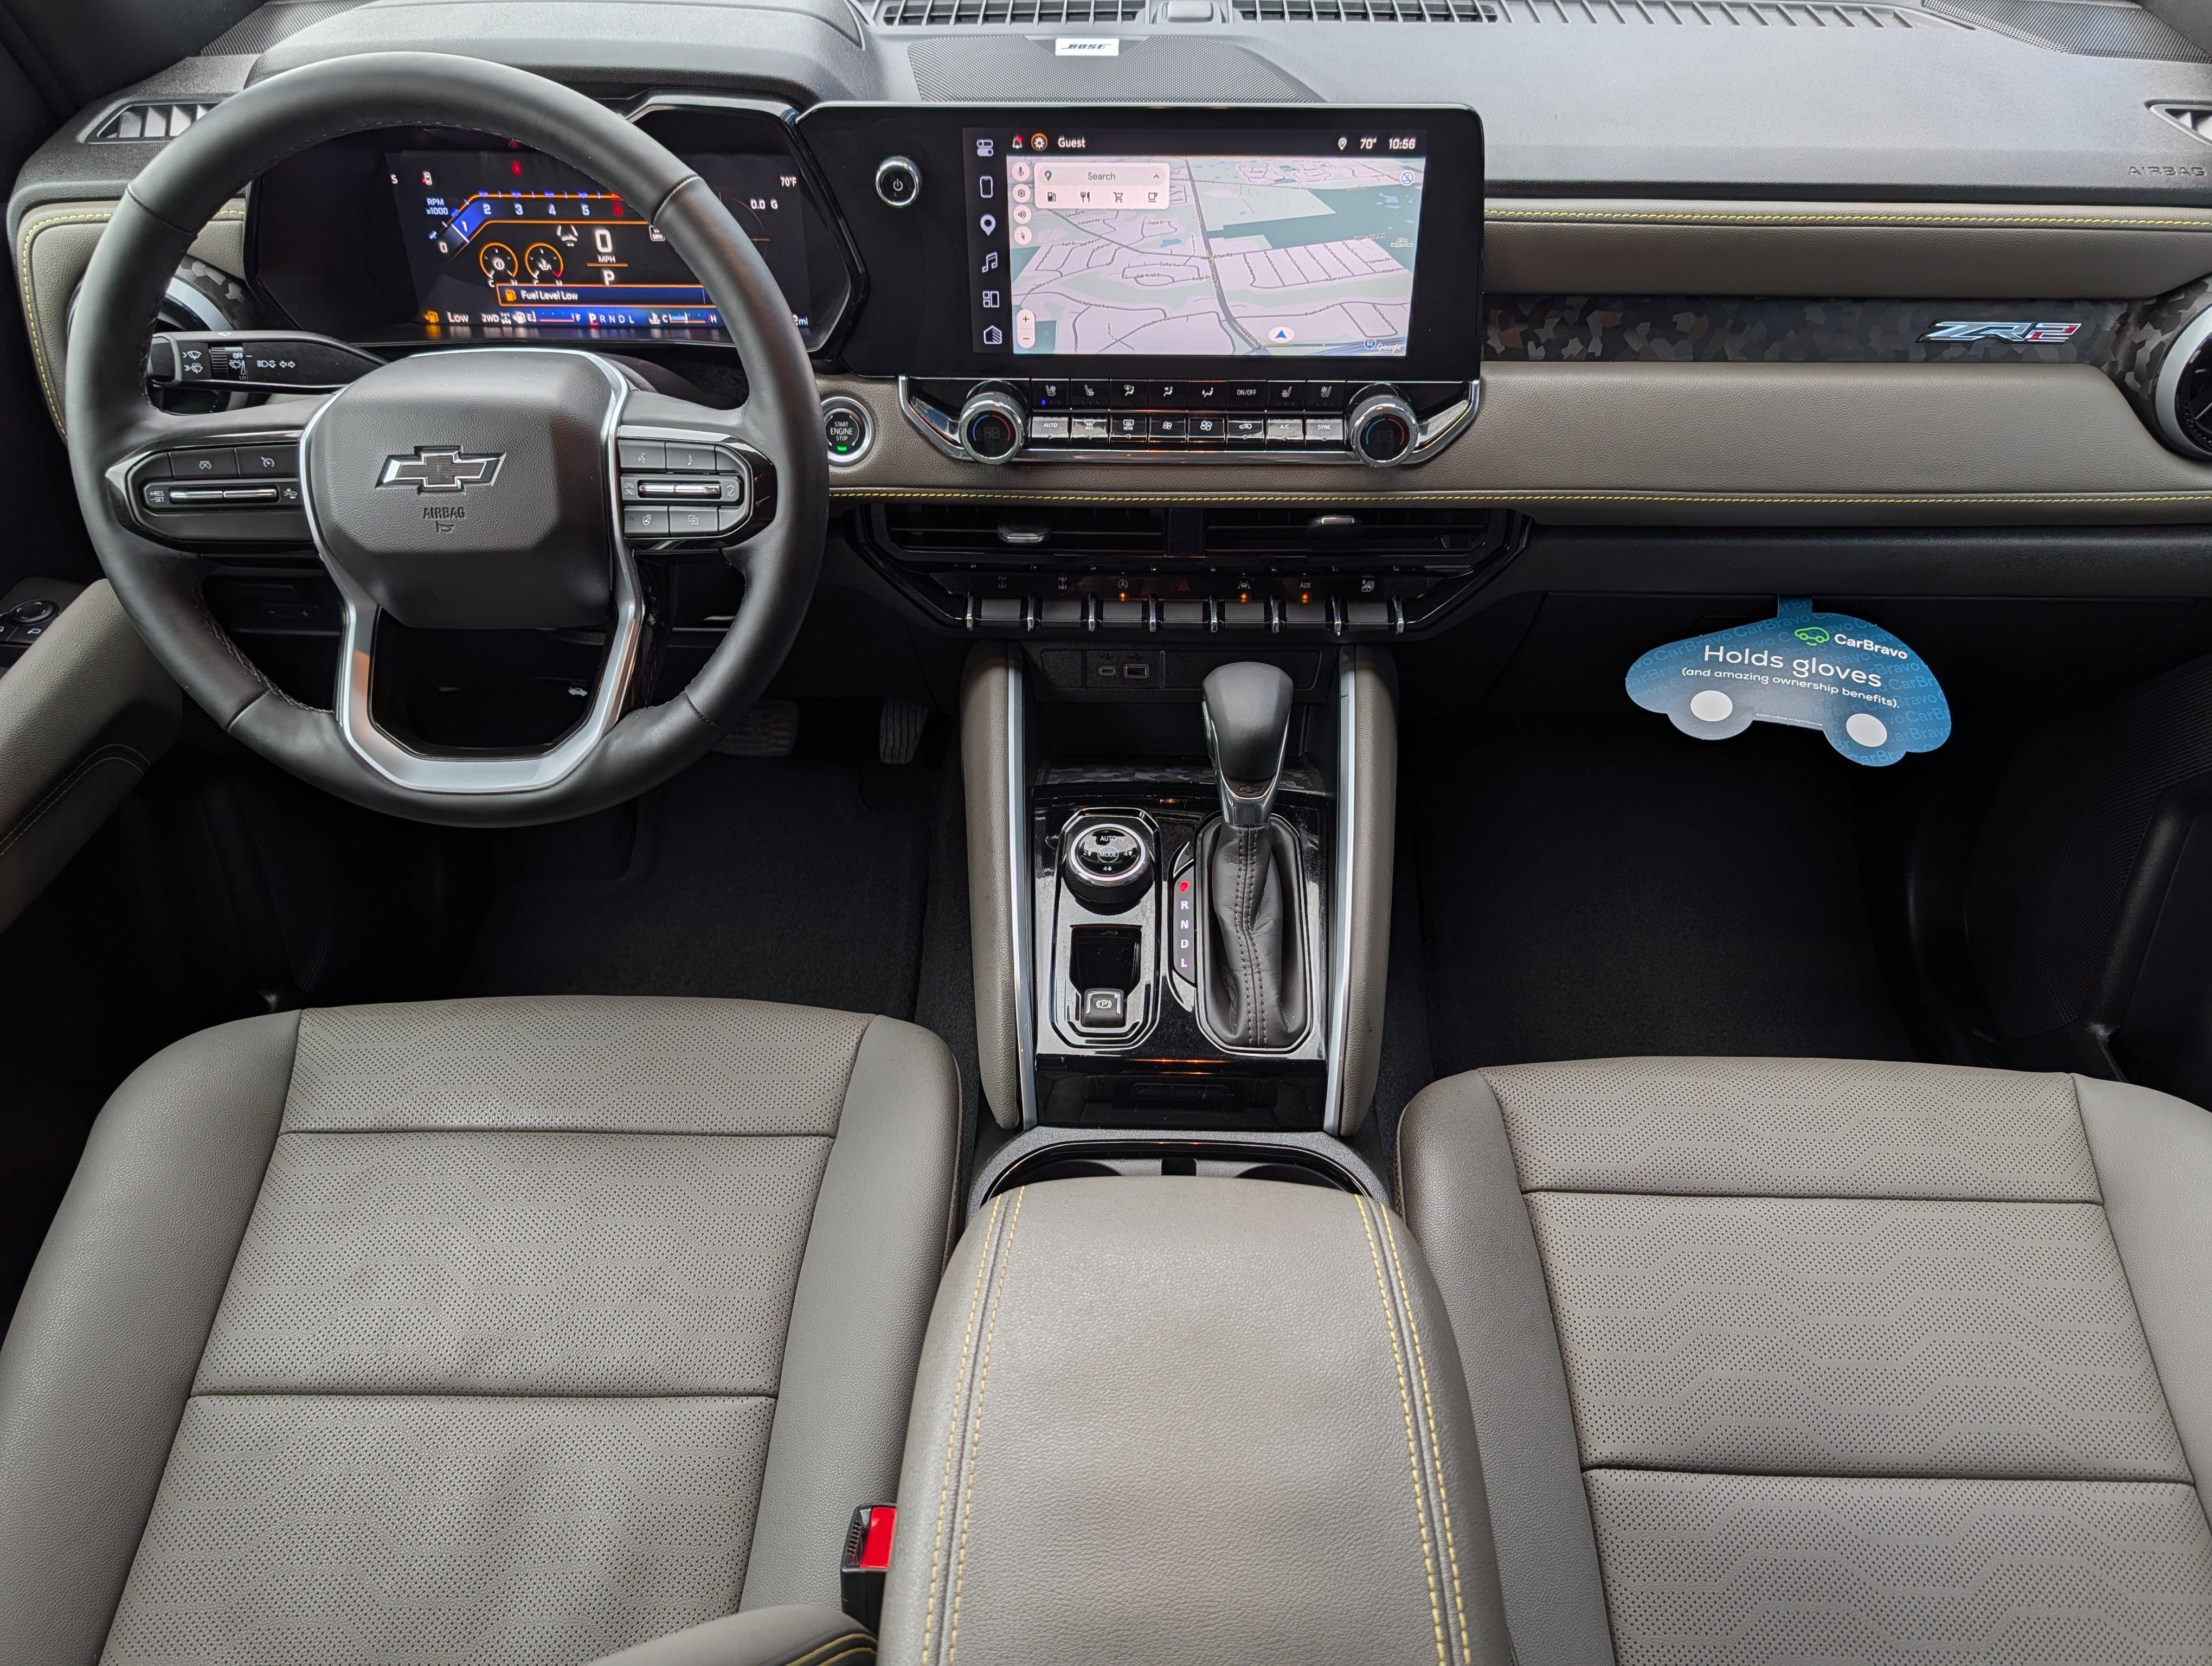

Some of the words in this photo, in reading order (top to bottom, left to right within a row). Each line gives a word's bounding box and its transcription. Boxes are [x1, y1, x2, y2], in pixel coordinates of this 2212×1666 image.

[1058, 137, 1085, 148] Guest
[1360, 138, 1377, 150] 70°
[1388, 138, 1416, 150] 10:56
[2130, 166, 2205, 176] AIRBAG
[390, 174, 398, 184] S
[780, 175, 796, 187] 70°F
[1088, 172, 1116, 181] Search
[427, 197, 445, 206] RPM
[750, 198, 766, 209] 0.0
[770, 198, 778, 209] G
[426, 207, 449, 215] x1000
[483, 203, 492, 215] 2
[515, 203, 523, 215] 3
[549, 204, 557, 216] 4
[581, 204, 590, 216] 5
[462, 221, 467, 232] 1
[595, 228, 613, 253] 0
[439, 241, 448, 253] 0
[597, 254, 616, 263] MPH
[603, 269, 615, 286] P
[488, 279, 495, 287] C
[1029, 283, 1046, 293] Meadow
[520, 290, 538, 300] Fuel
[540, 290, 561, 300] Level
[561, 291, 578, 300] Low
[1304, 306, 1326, 316] Brookview
[446, 311, 468, 323] Low
[481, 313, 499, 323] 2WD
[527, 313, 532, 322] E
[576, 313, 581, 322] F
[589, 313, 596, 323] P
[600, 315, 606, 323] R
[609, 315, 616, 323] N
[619, 315, 625, 323] D
[629, 315, 634, 324] L
[662, 315, 668, 323] C
[710, 315, 717, 323] H
[1142, 319, 1163, 328] Woodbine
[1915, 320, 2083, 344] ZR2
[1377, 343, 1401, 353] Google
[423, 507, 465, 519] AIRBAG
[1834, 634, 1908, 659] CarBravo
[1704, 645, 1784, 668] Holds
[1792, 657, 1881, 687] gloves
[1682, 667, 1711, 677] (and
[1714, 671, 1769, 684] amazing
[1773, 677, 1839, 695] ownership
[1842, 687, 1900, 708] benefits).
[1181, 882, 1188, 892] P
[1181, 901, 1189, 910] R
[1181, 920, 1188, 929] N
[1181, 939, 1188, 949] D
[1181, 958, 1187, 967] L
